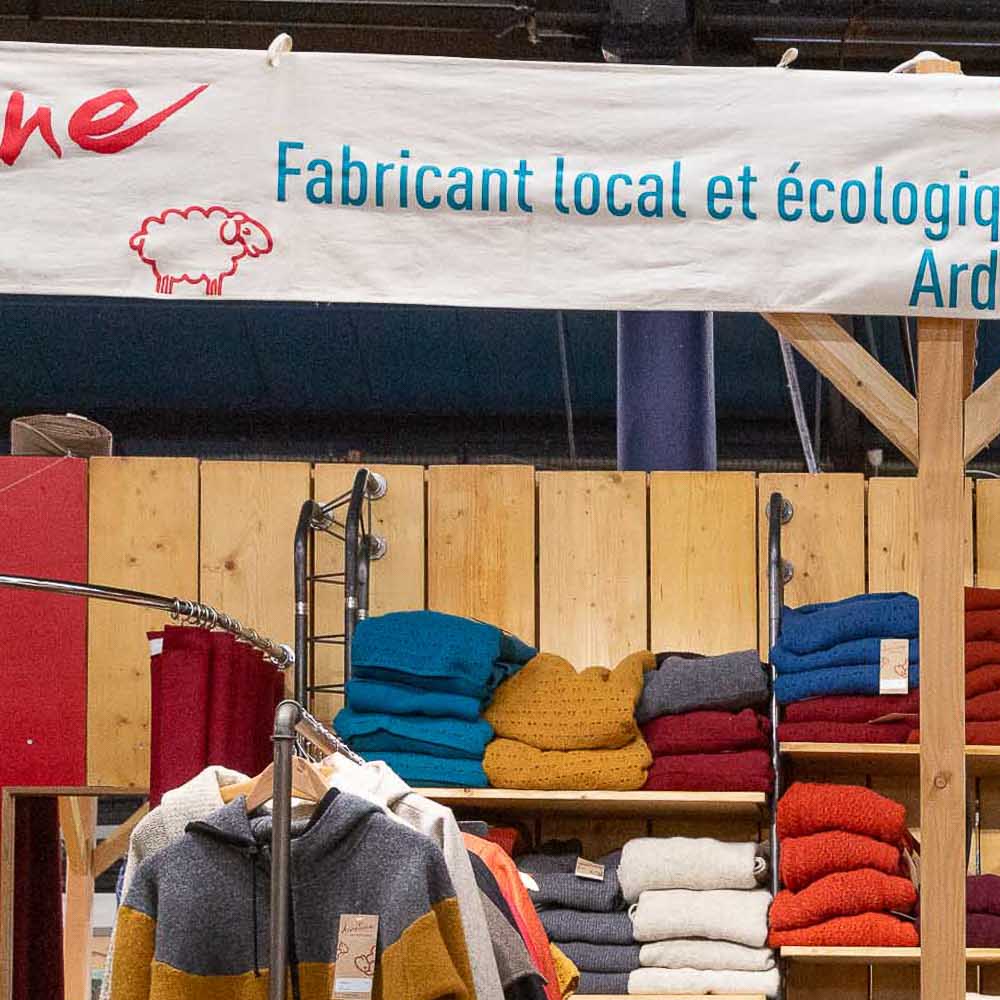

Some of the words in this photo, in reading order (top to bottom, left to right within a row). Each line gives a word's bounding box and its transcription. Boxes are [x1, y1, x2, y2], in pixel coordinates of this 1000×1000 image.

[277, 141, 534, 214] Fabricant
[554, 156, 687, 218] local
[706, 165, 757, 221] et
